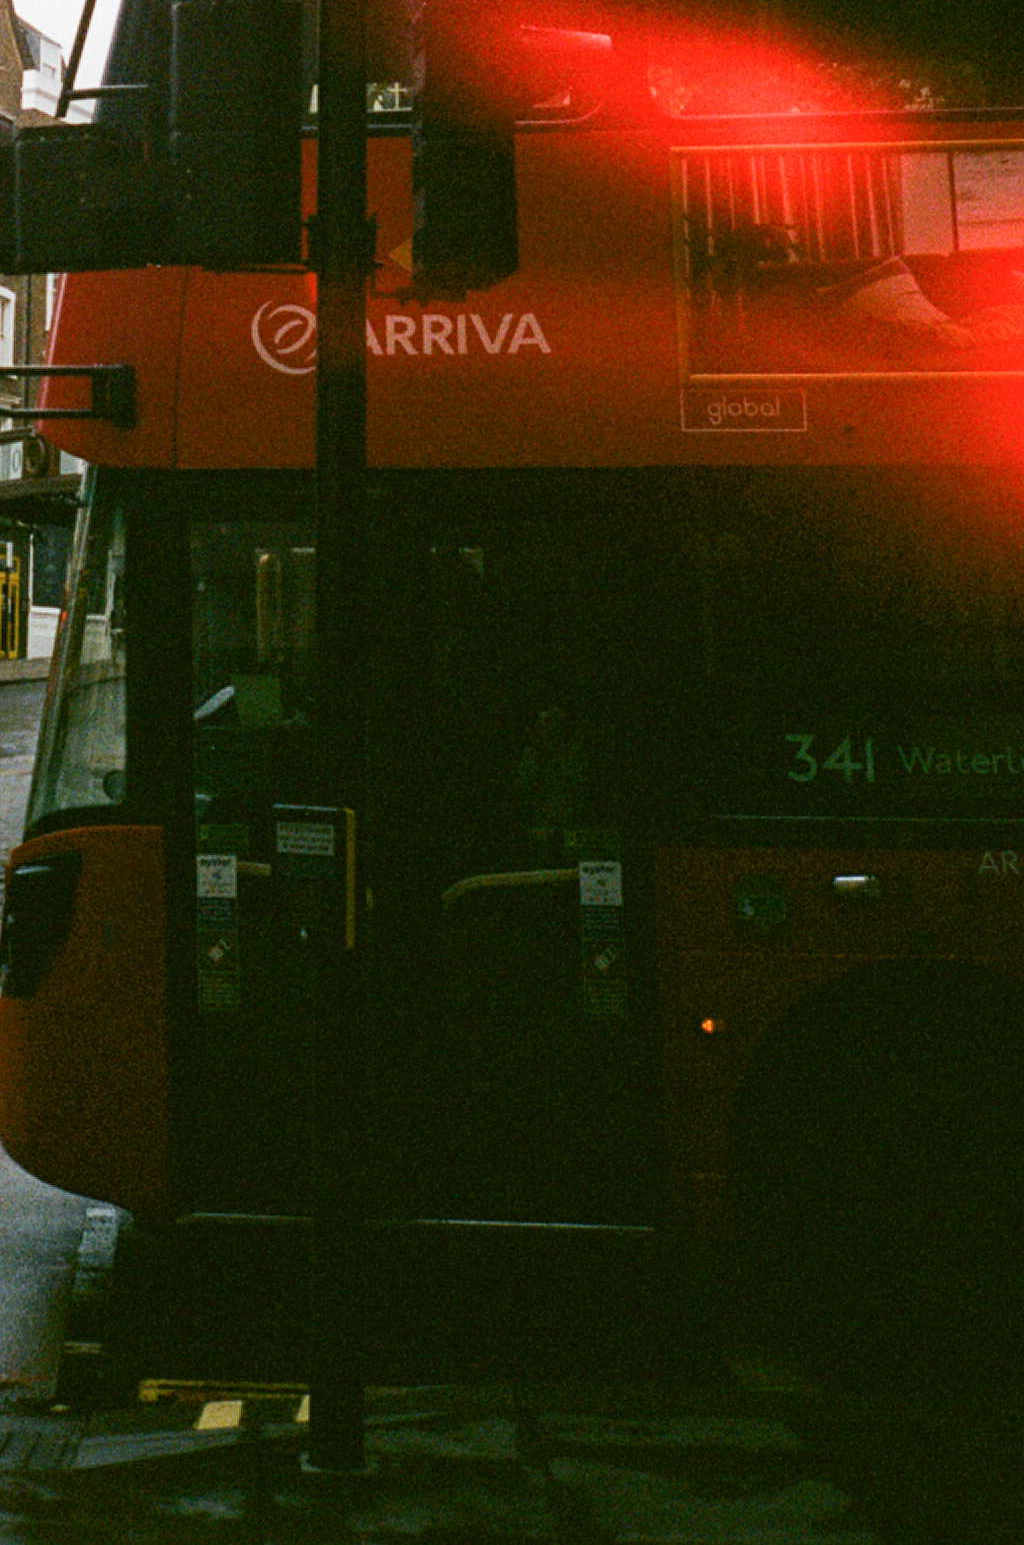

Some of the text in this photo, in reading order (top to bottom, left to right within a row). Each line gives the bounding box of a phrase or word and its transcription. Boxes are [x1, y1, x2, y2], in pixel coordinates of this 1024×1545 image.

[707, 396, 780, 425] global
[785, 733, 1023, 783] 341 Waterl
[978, 849, 1019, 875] AR
